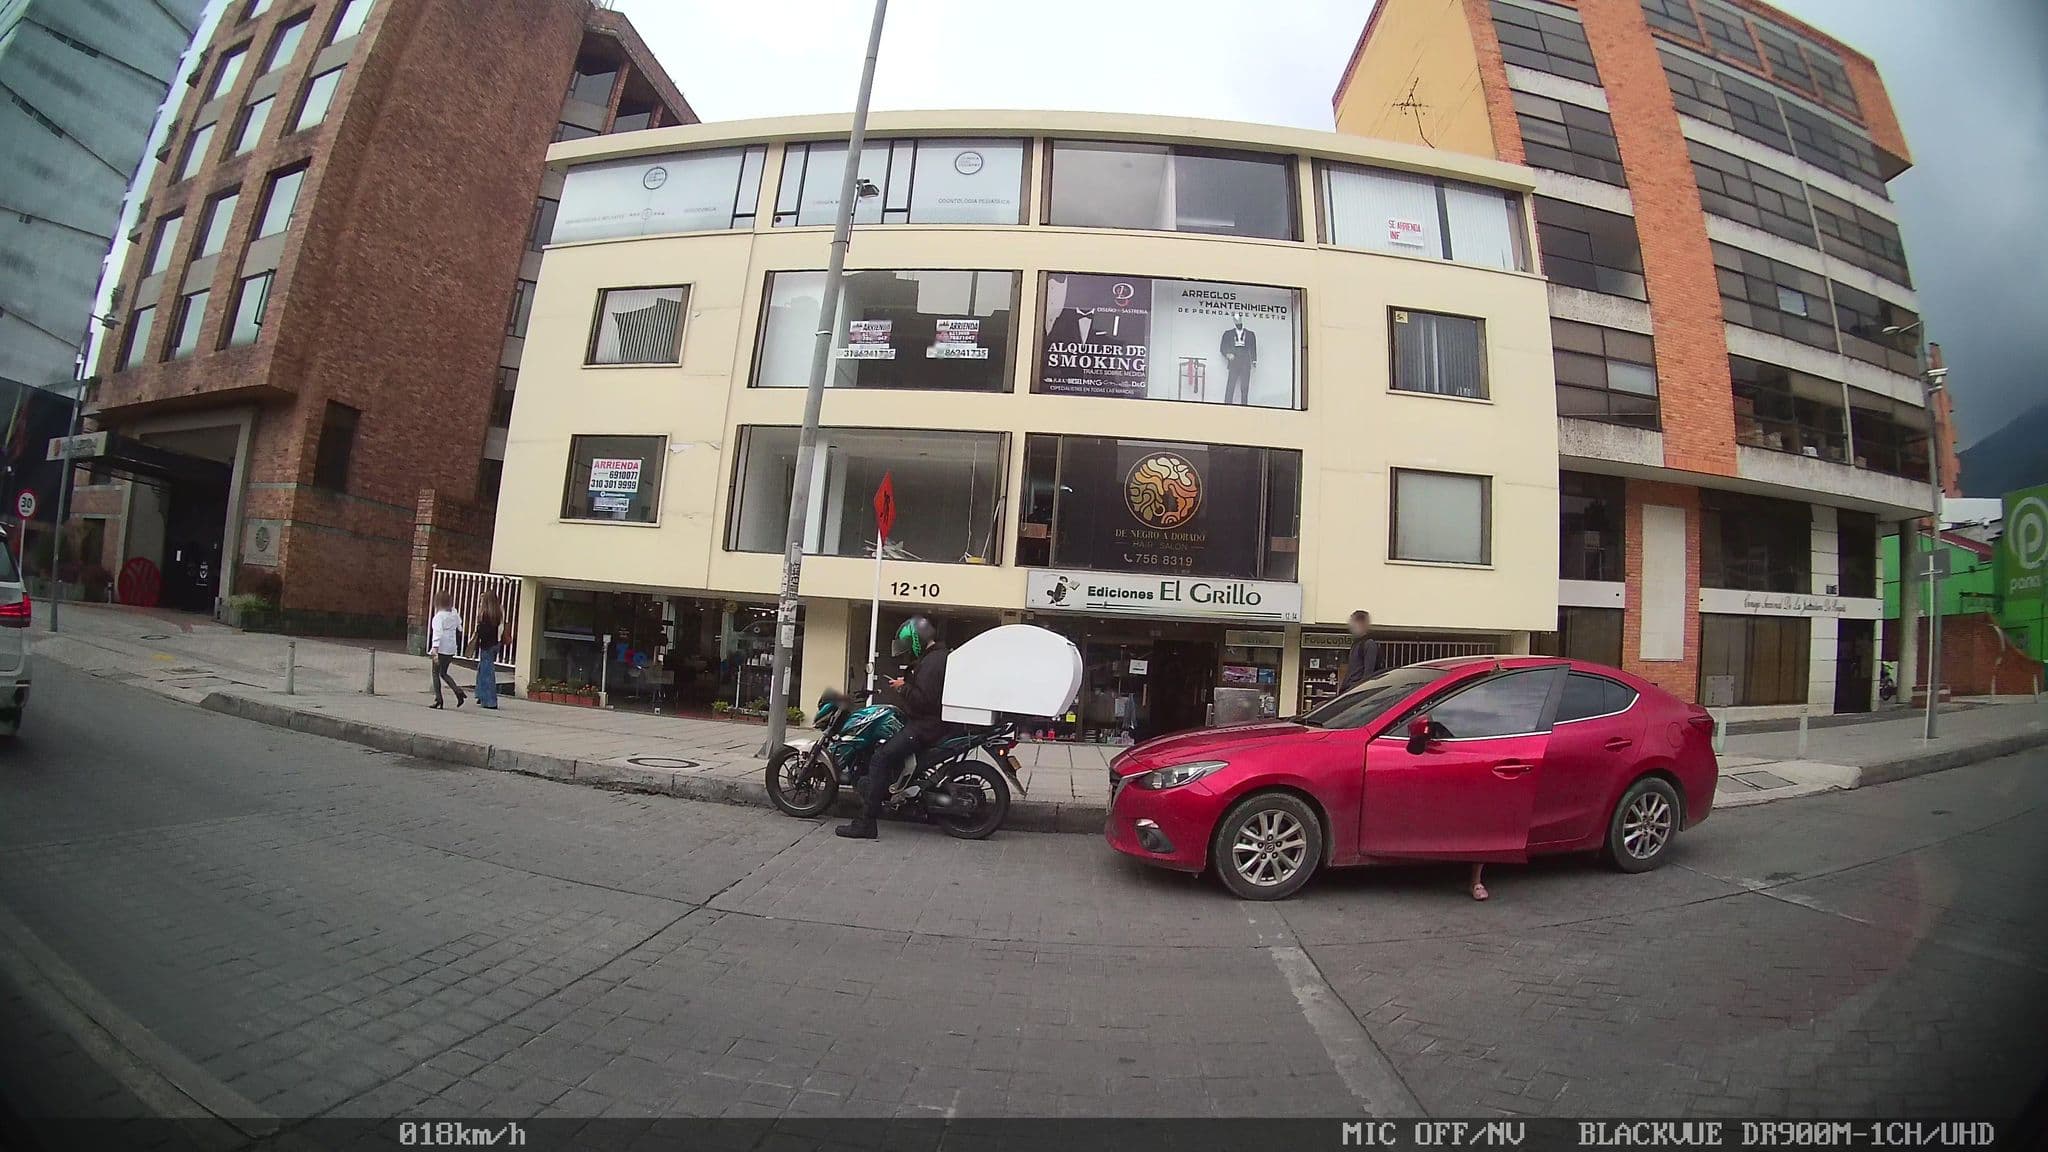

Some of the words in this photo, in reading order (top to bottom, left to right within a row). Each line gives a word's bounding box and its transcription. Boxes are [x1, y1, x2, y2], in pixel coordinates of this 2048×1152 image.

[1182, 290, 1236, 300] ARREGLOS
[1205, 301, 1288, 314] MANTENIMIENTO
[1048, 342, 1122, 356] ALQUILER
[1126, 346, 1147, 357] DE
[1048, 354, 1147, 372] SMOKING
[594, 461, 638, 470] ARRIENDA
[610, 470, 638, 480] 6910077
[591, 480, 603, 488] 310
[604, 480, 616, 488] 301
[618, 481, 636, 489] 9999
[21, 496, 32, 508] 30
[1131, 530, 1160, 539] NEGRO
[1136, 554, 1158, 564] 756
[1163, 556, 1192, 566] 8319
[1088, 586, 1154, 600] Ediciones
[1160, 580, 1181, 601] El
[1190, 583, 1262, 606] Grillo
